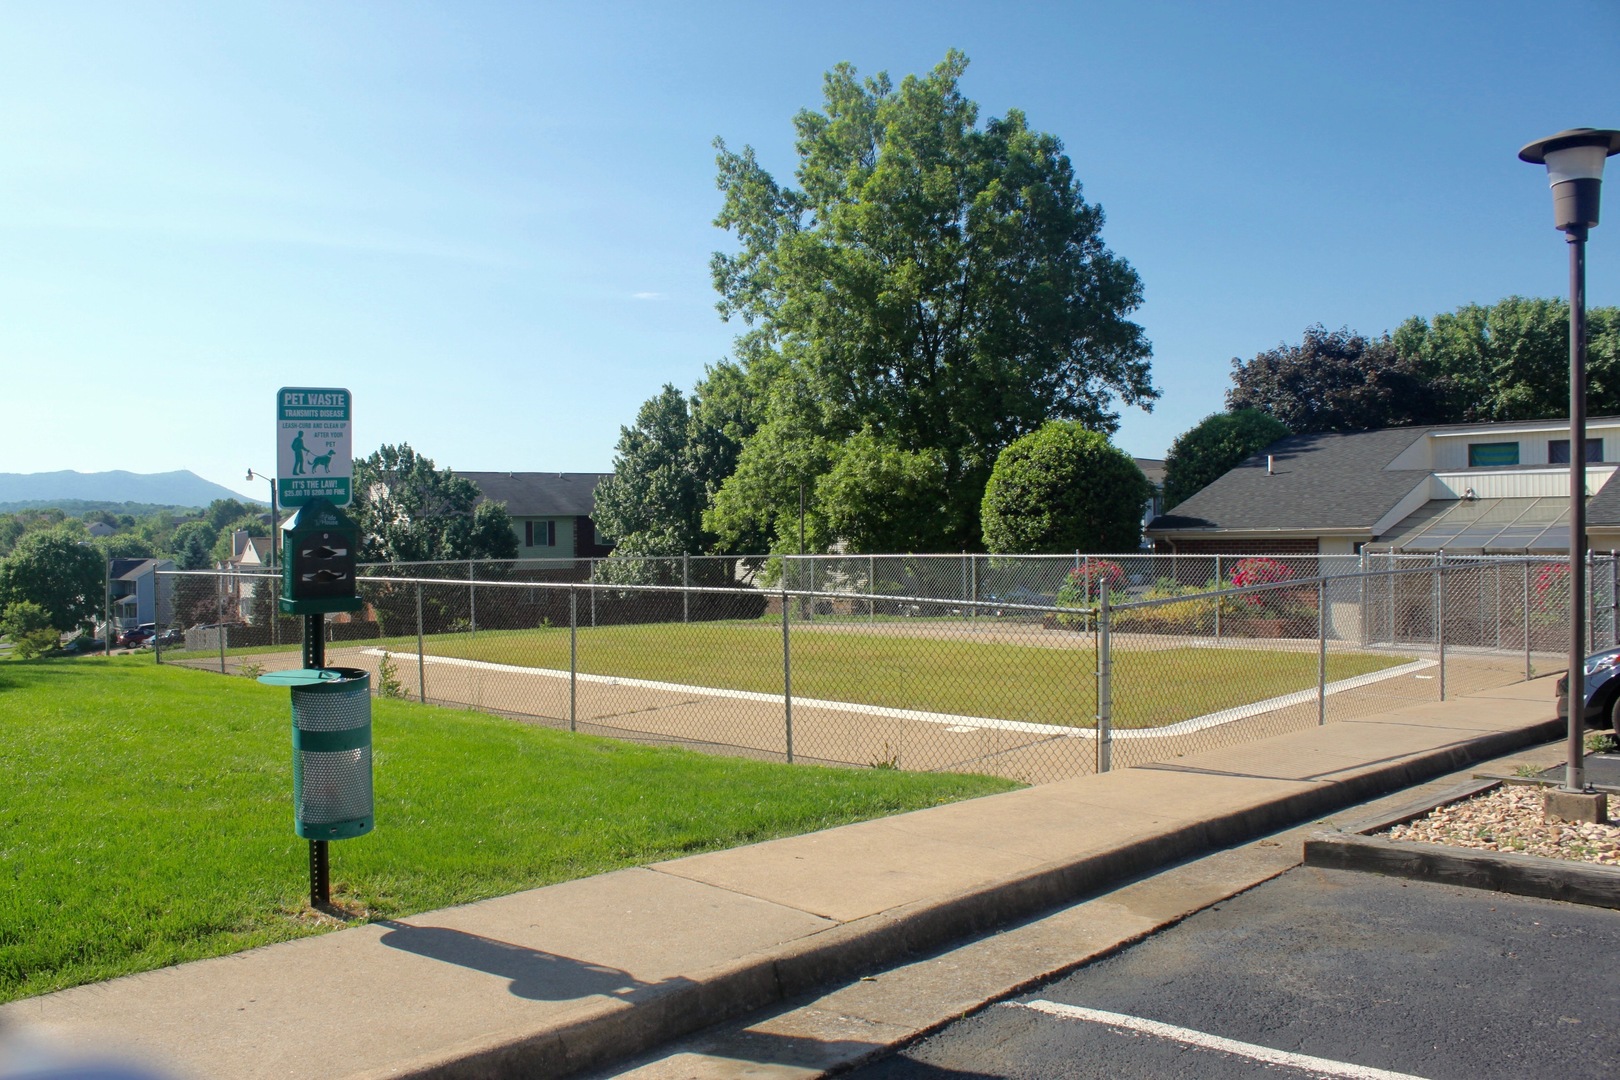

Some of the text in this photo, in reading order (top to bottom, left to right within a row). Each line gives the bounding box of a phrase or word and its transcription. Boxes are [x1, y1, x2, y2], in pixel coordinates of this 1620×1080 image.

[284, 393, 344, 405] PET WASTE
[285, 409, 344, 417] TRANSMITS DISEASE
[292, 480, 337, 489] IT'S THE LAW!
